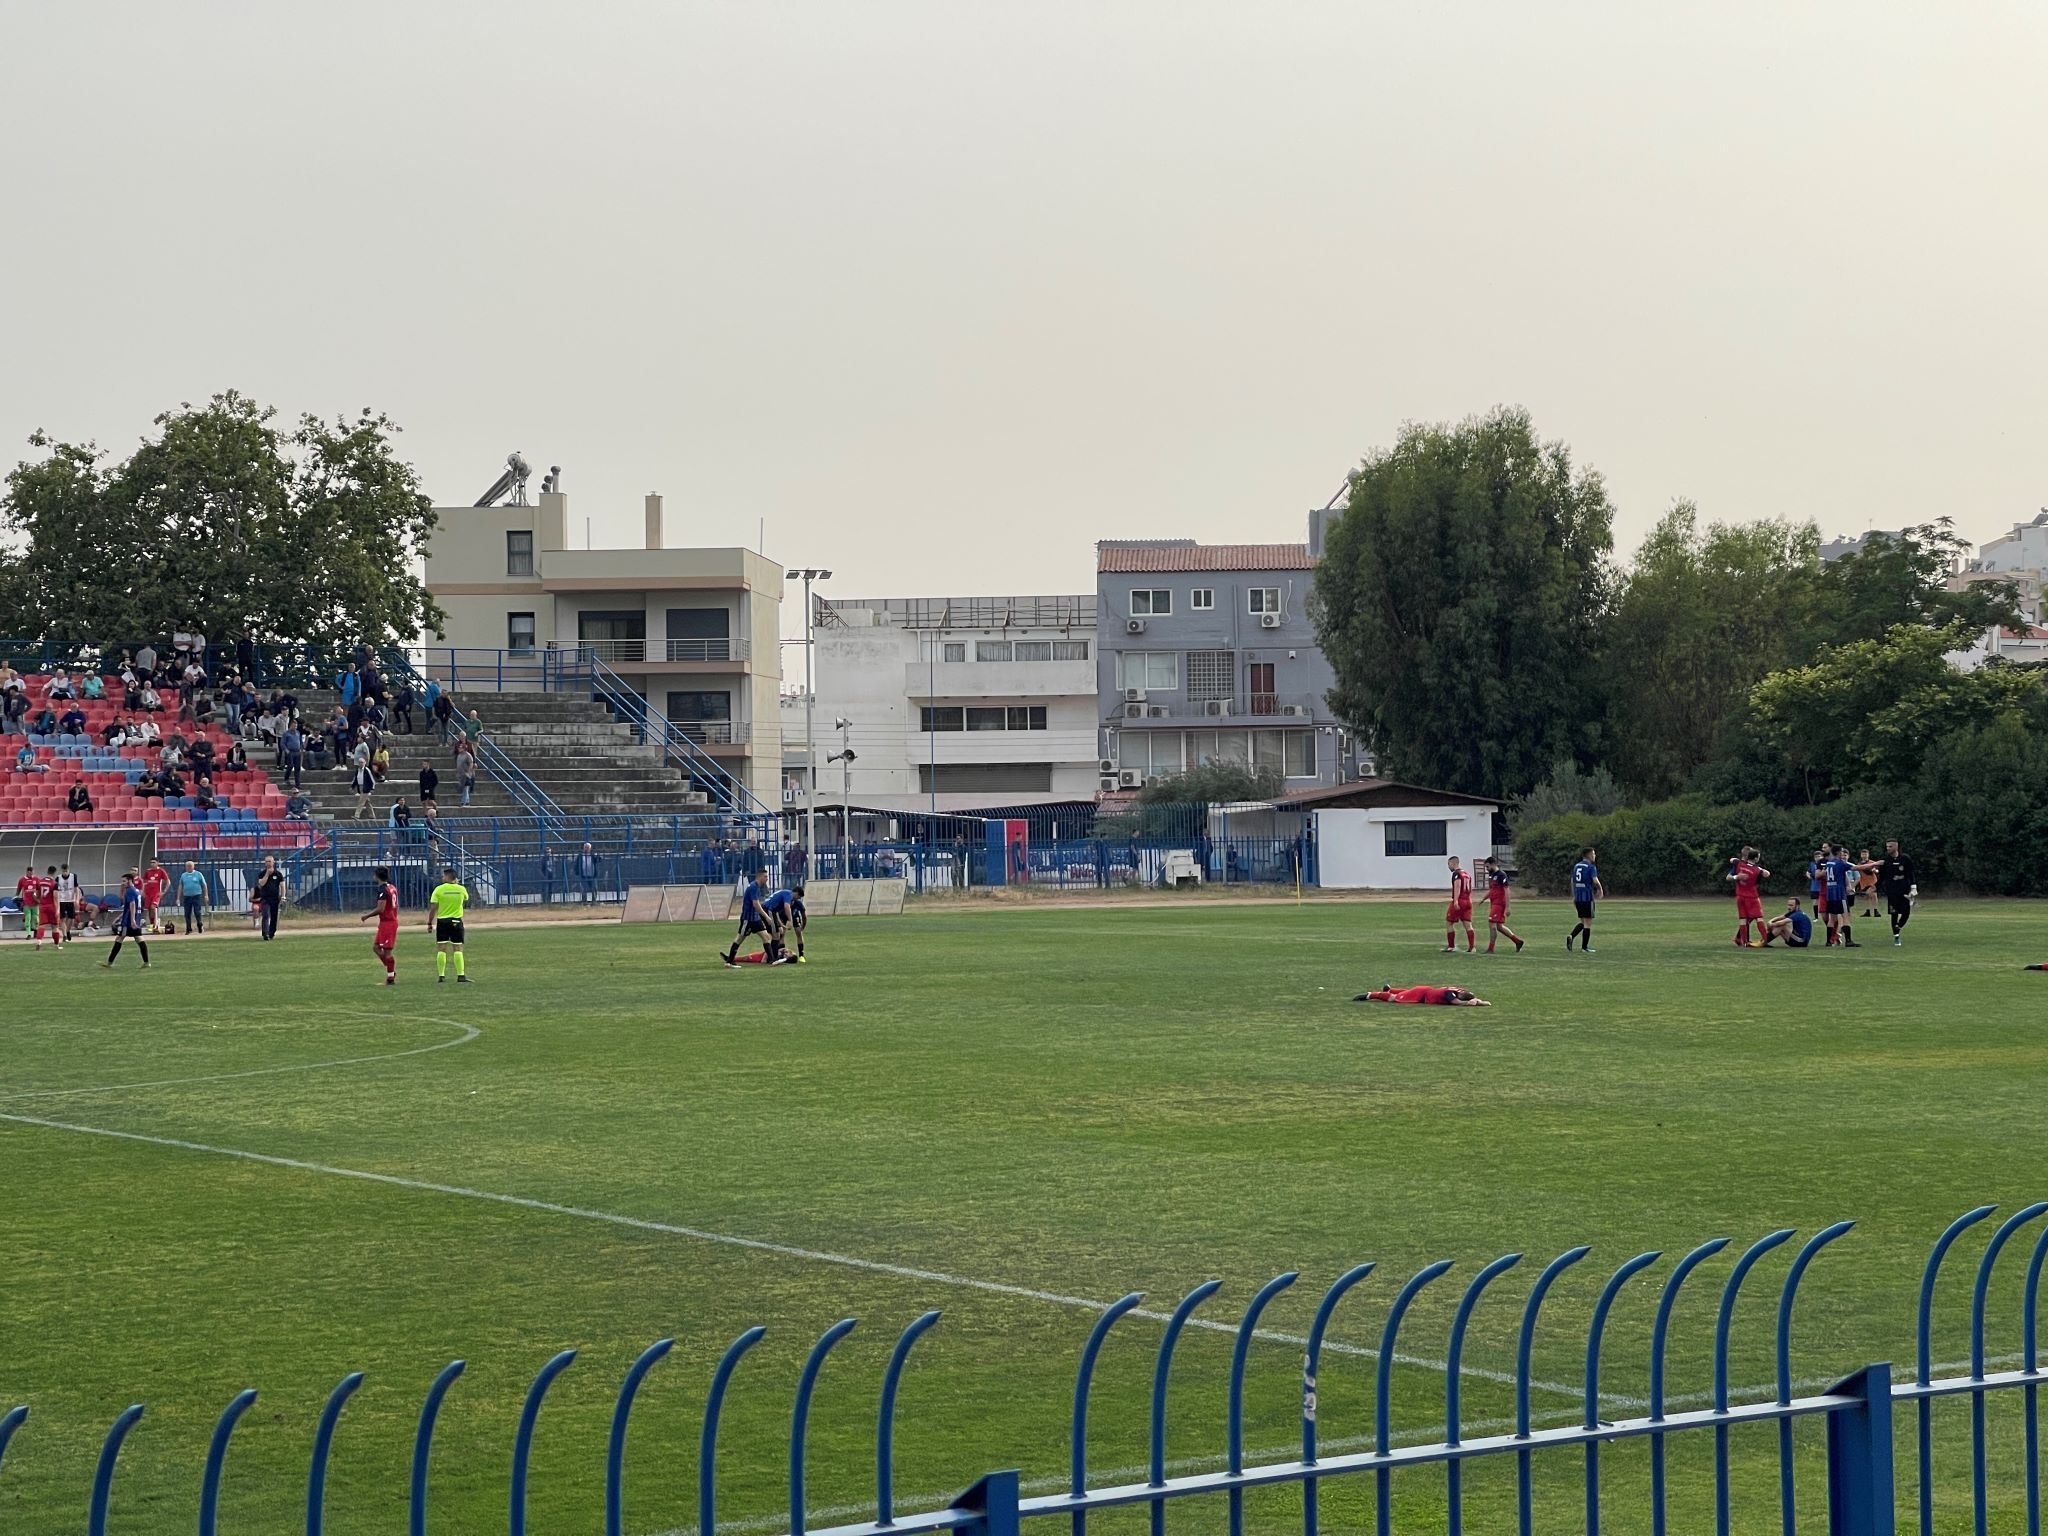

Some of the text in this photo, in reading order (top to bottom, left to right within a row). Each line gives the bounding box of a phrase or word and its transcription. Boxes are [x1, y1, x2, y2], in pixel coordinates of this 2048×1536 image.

[1575, 867, 1583, 882] 5
[1826, 866, 1835, 881] 14
[40, 885, 50, 897] 17
